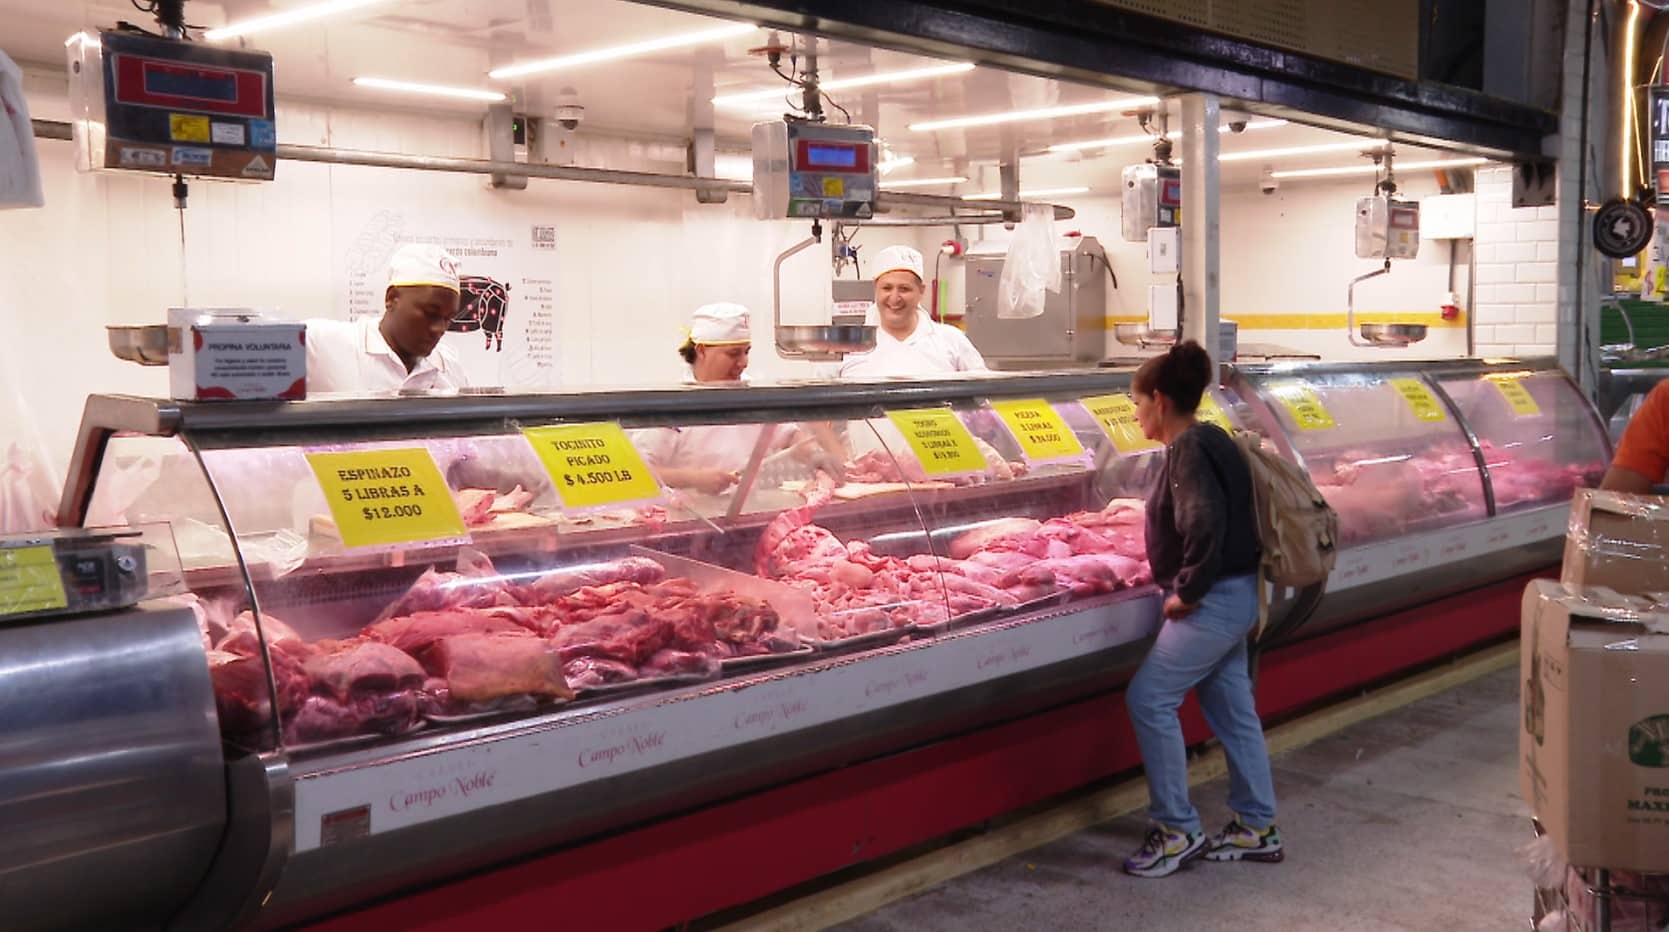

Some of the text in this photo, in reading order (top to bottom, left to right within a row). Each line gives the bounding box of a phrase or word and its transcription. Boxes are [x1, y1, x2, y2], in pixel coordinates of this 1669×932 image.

[208, 343, 292, 351] PROPINA VOLUNTARIA
[551, 438, 605, 451] TOCINITO
[566, 454, 610, 467] PICADO
[338, 466, 411, 481] ESPINAZO
[612, 469, 632, 481] LB
[342, 484, 425, 501] 5 LIBRAS A
[362, 504, 422, 520] $12.000
[578, 730, 668, 768] Campo Noble
[389, 770, 496, 812] Campo Noble
